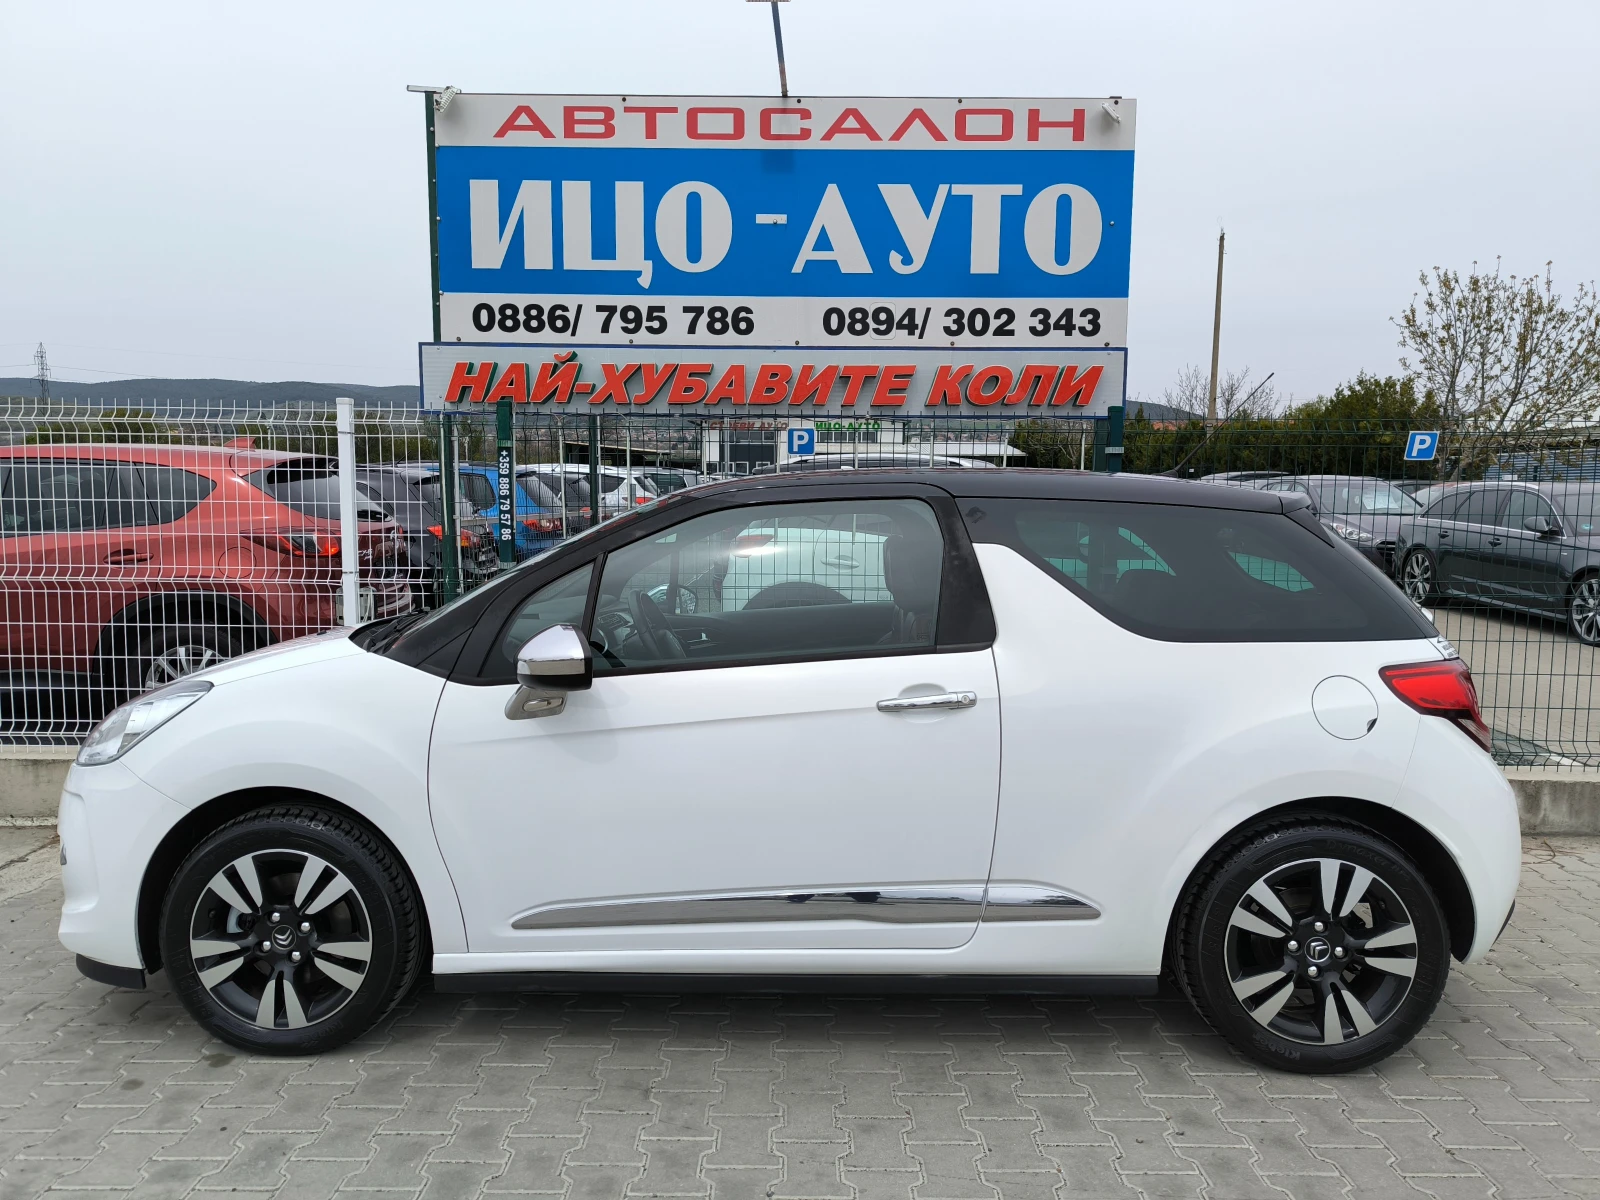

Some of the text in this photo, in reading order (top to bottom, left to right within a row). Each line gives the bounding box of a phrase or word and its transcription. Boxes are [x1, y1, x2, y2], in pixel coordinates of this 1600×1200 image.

[493, 105, 1086, 142] АВТОСАЛОН
[472, 303, 755, 337] 0886/ 795 786
[822, 306, 1101, 340] 0894/ 302 343
[444, 351, 1105, 408] НАЙ-ХУБАВИТЕ КОЛИ
[793, 430, 810, 452] P
[1411, 434, 1432, 457] P
[499, 449, 512, 541] +359 886 79 57 86
